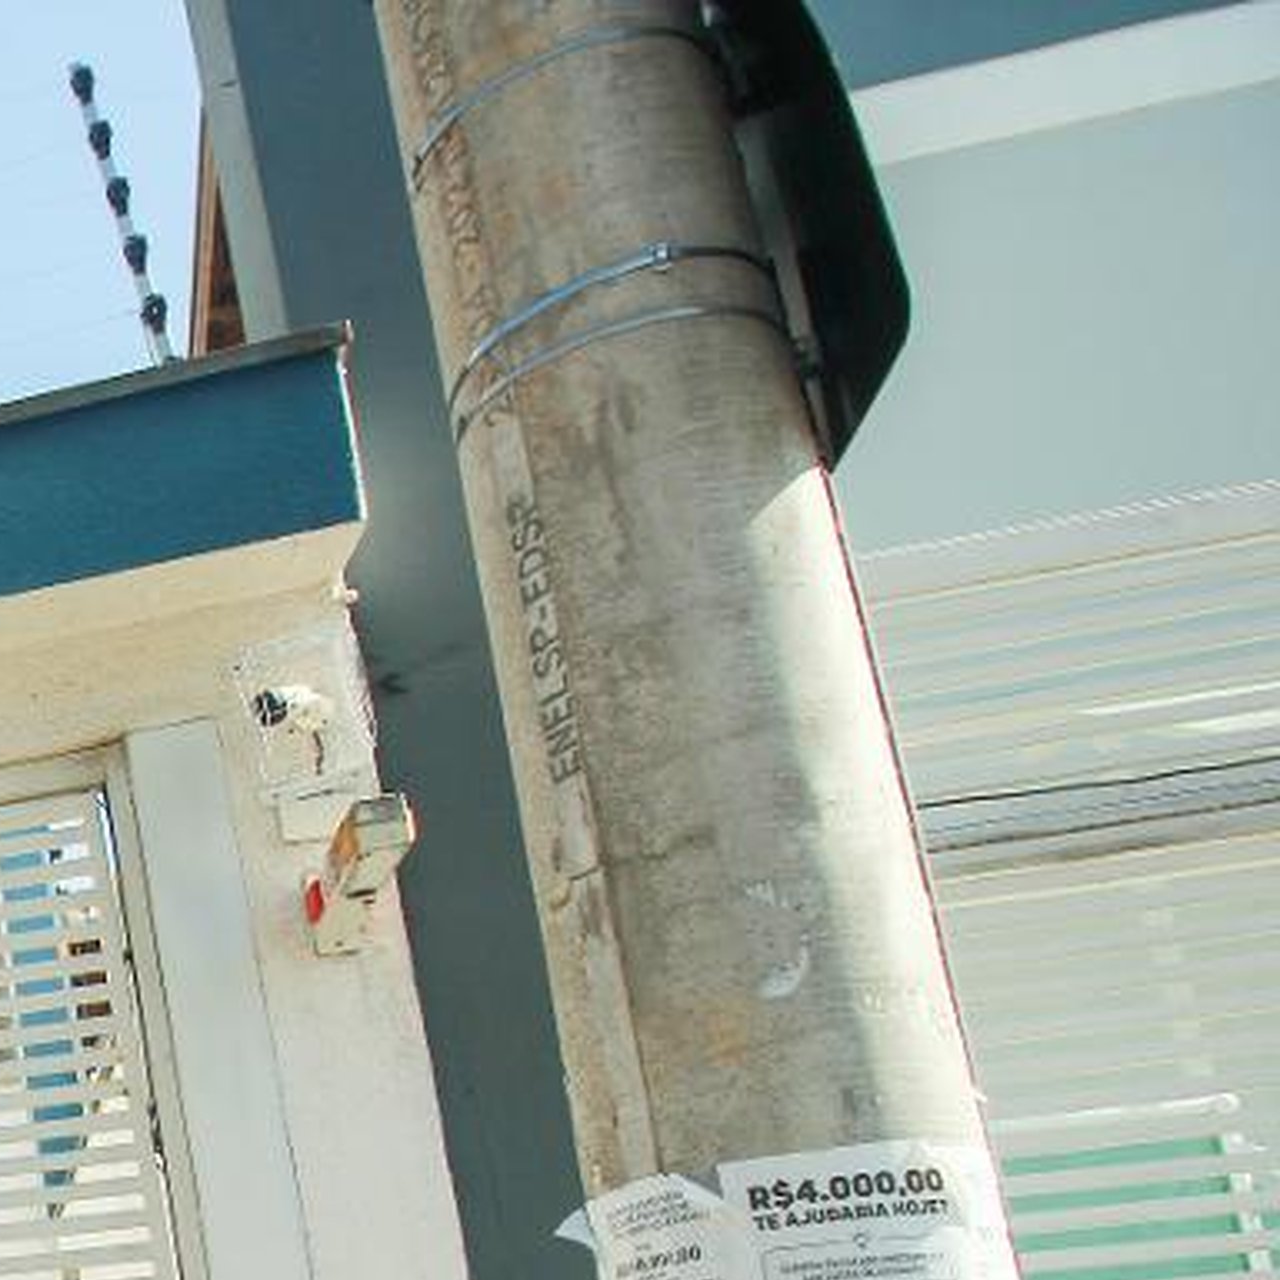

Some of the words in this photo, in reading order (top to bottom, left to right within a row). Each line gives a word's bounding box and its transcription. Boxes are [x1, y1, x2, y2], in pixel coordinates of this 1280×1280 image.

[747, 1169, 944, 1211] R$4.000,00
[753, 1214, 781, 1231] TE
[786, 1203, 889, 1228] AJUDARIA
